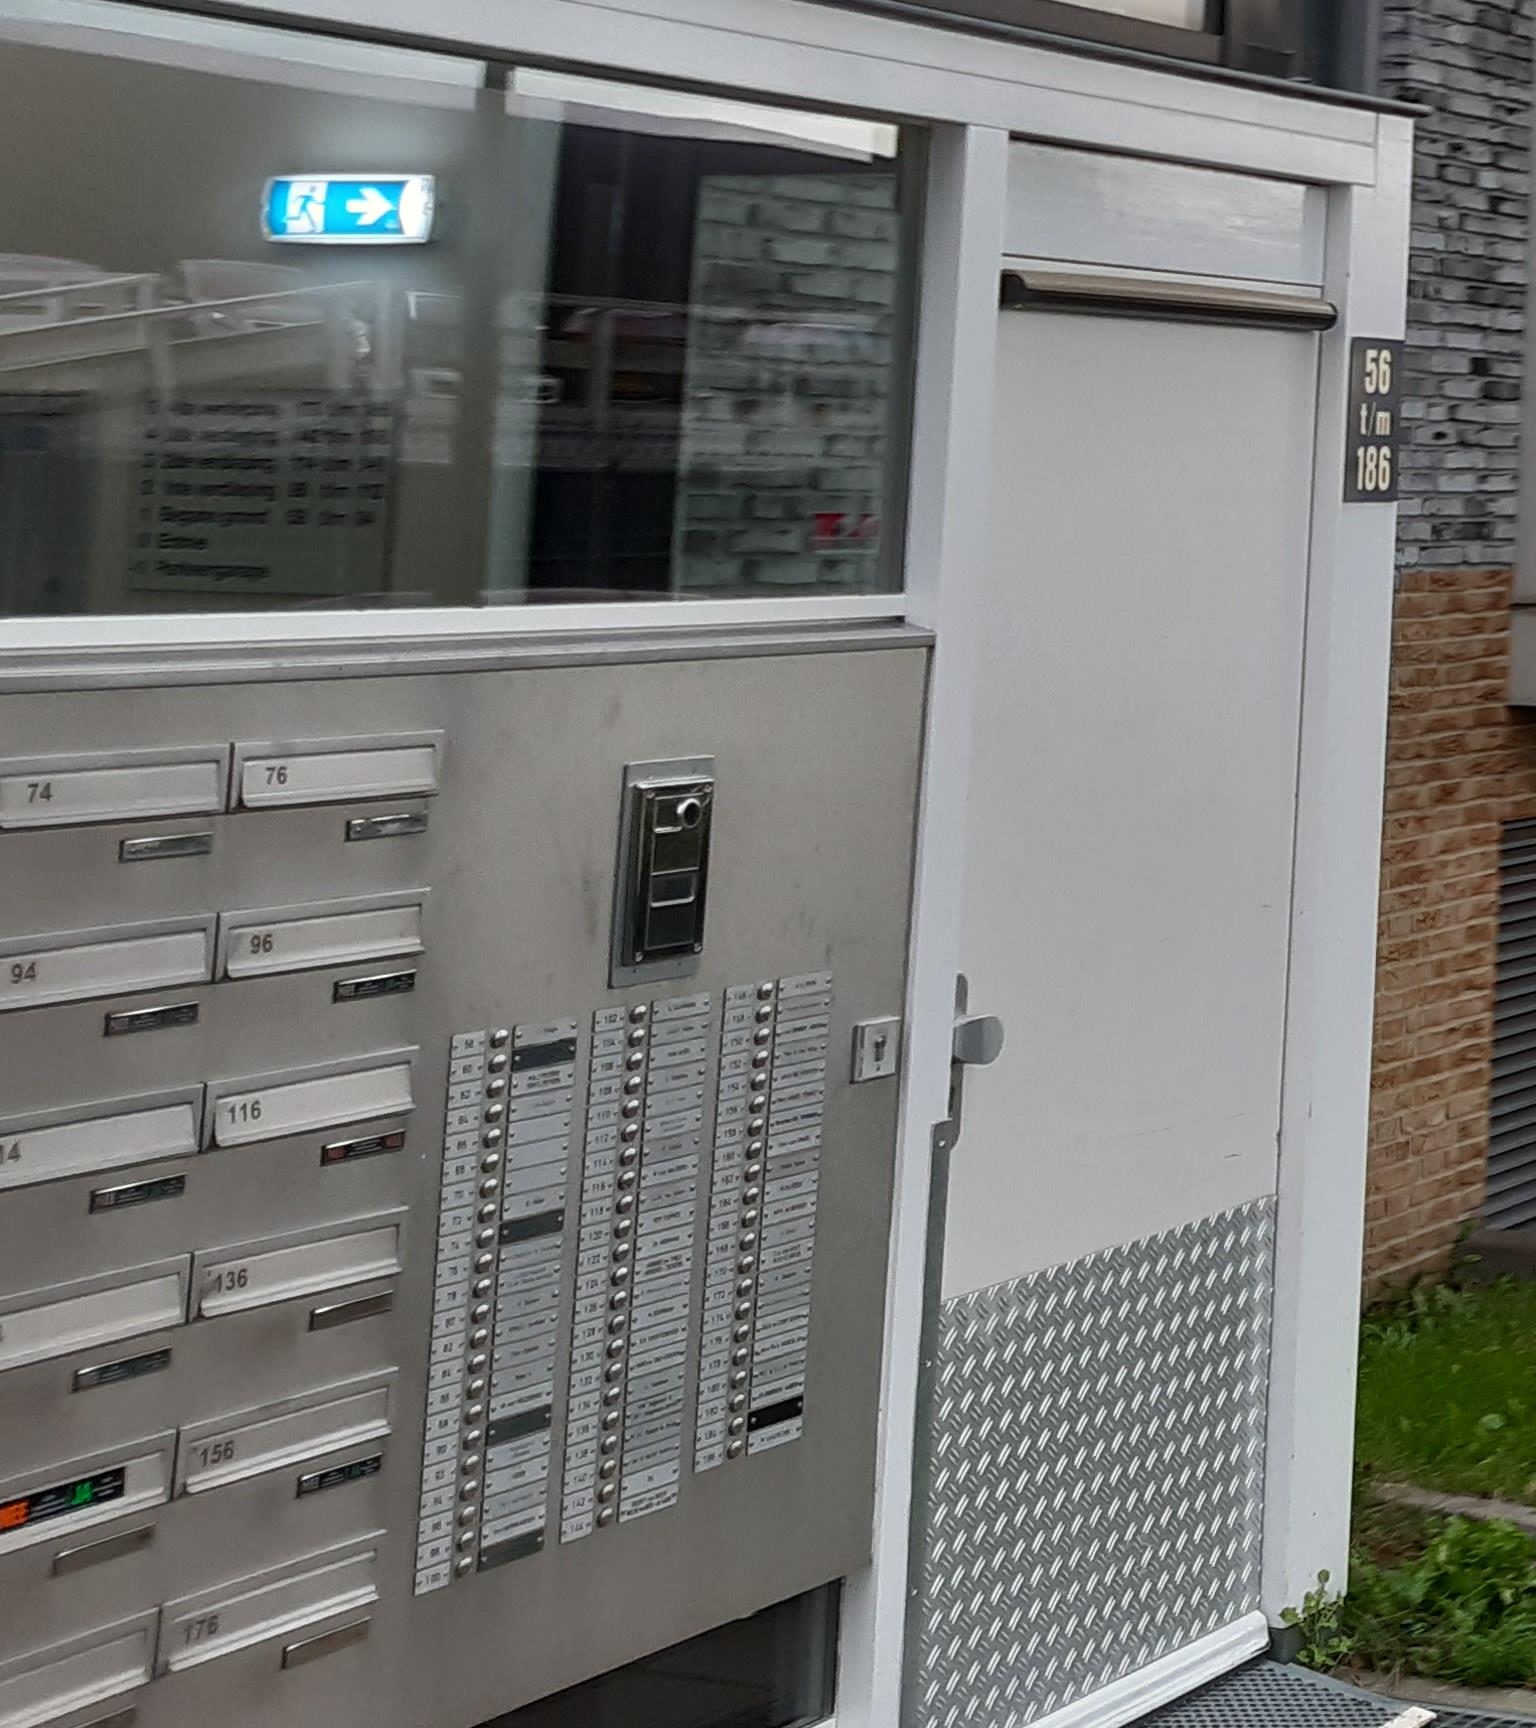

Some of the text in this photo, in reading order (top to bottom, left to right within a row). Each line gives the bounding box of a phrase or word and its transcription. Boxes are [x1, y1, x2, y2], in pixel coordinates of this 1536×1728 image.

[1364, 349, 1392, 395] 56
[1360, 402, 1391, 437] t/m
[1356, 446, 1391, 492] 186
[265, 766, 289, 785] 76
[27, 783, 53, 803] 74
[250, 934, 274, 954] 96
[11, 963, 37, 984] 94
[228, 1100, 262, 1125] 116
[212, 1269, 249, 1293] 136
[199, 1440, 235, 1468] 156
[183, 1615, 220, 1643] 176
